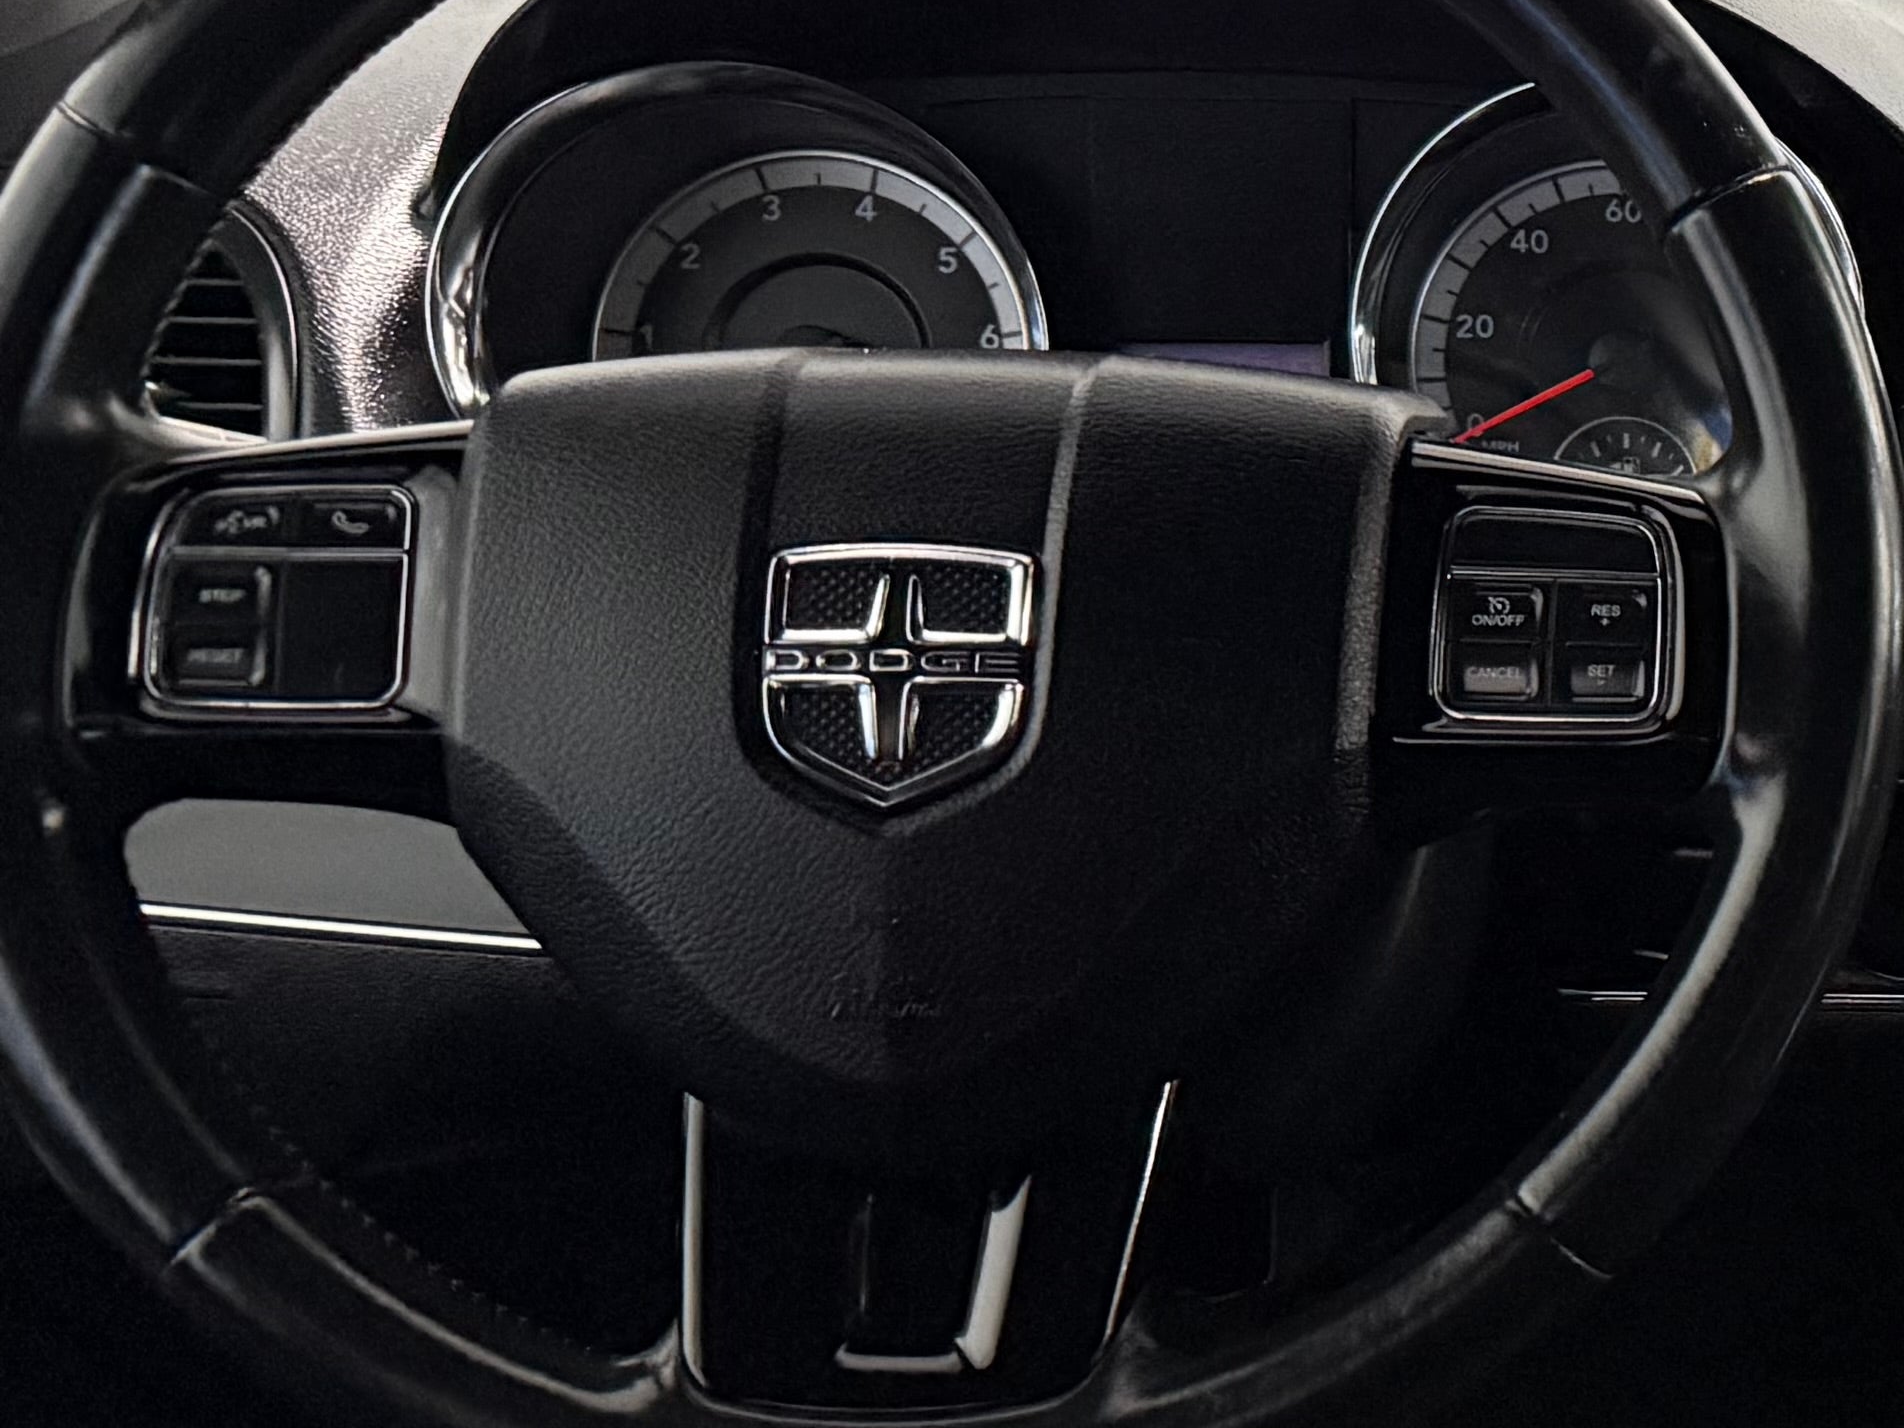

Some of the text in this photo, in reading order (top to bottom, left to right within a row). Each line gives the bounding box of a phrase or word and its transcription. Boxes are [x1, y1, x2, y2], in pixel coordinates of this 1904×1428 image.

[762, 195, 782, 221] 3
[853, 195, 878, 221] 4
[1605, 198, 1642, 223] 60
[1510, 229, 1549, 254] 40
[680, 242, 701, 269] 2
[937, 246, 959, 274] 5
[978, 324, 1000, 349] 6
[1455, 313, 1495, 339] 20
[1590, 603, 1621, 617] RES
[763, 648, 1023, 673] DODGE
[1586, 664, 1616, 677] SET
